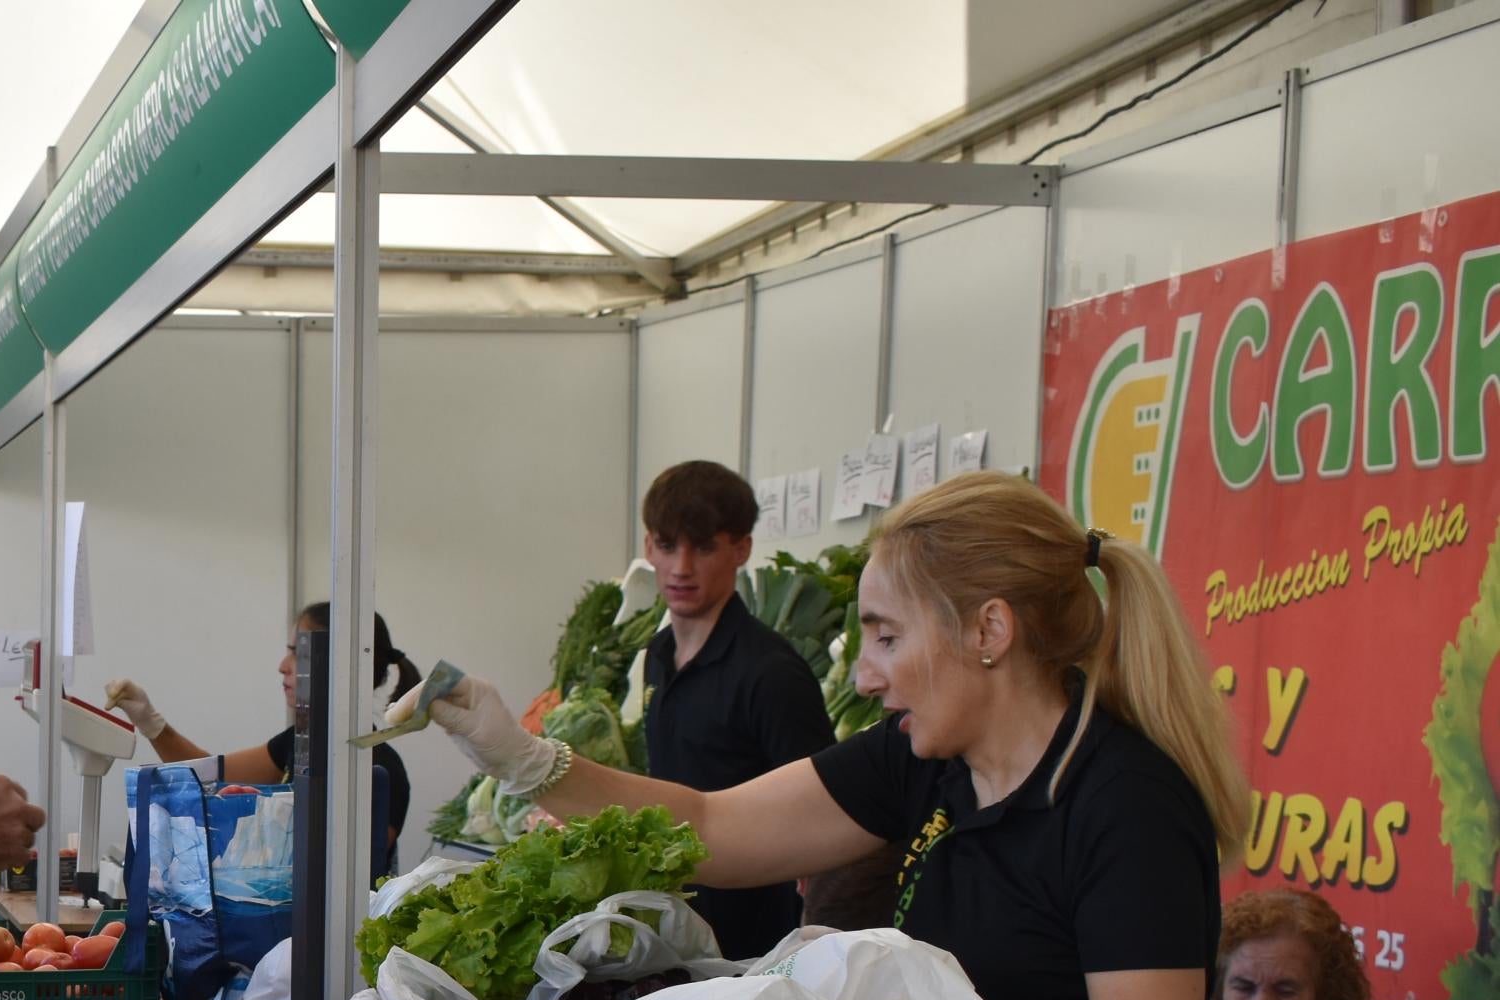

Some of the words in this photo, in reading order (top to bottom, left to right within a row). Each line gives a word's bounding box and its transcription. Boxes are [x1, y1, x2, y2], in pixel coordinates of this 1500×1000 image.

[83, 118, 139, 229] CARRASCO
[1211, 244, 1500, 490] CARR
[1206, 548, 1351, 635] Produccion
[1362, 497, 1469, 580] Propia
[1262, 666, 1306, 751] Y
[1244, 790, 1407, 887] URAS
[1374, 929, 1405, 971] 25
